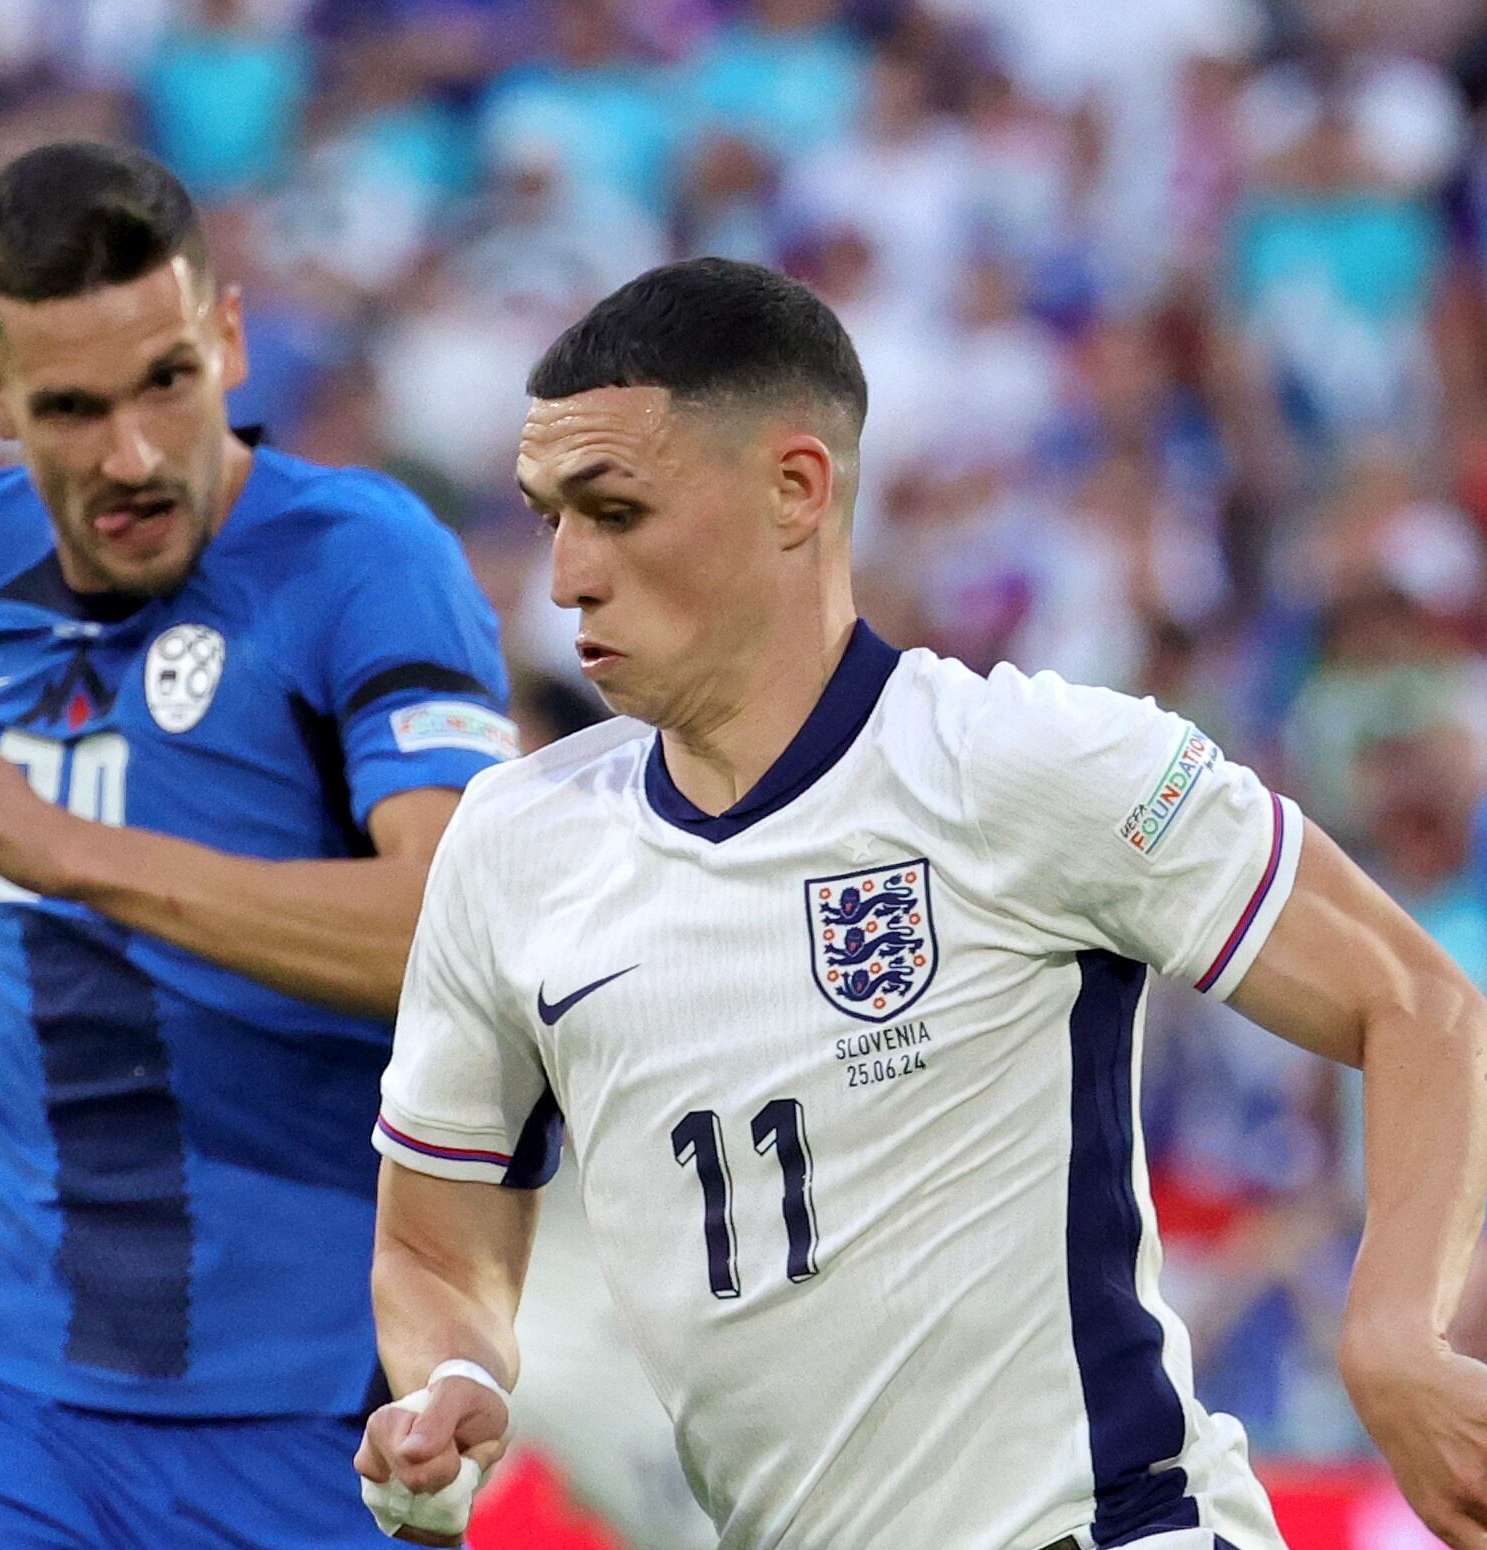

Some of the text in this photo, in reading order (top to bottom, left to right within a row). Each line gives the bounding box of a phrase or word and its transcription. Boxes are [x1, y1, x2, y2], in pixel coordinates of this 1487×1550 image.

[1120, 804, 1147, 838] UEFA
[835, 1021, 931, 1060] SLOVENIA
[847, 1051, 926, 1087] 25.06.24
[671, 1098, 820, 1299] 11
